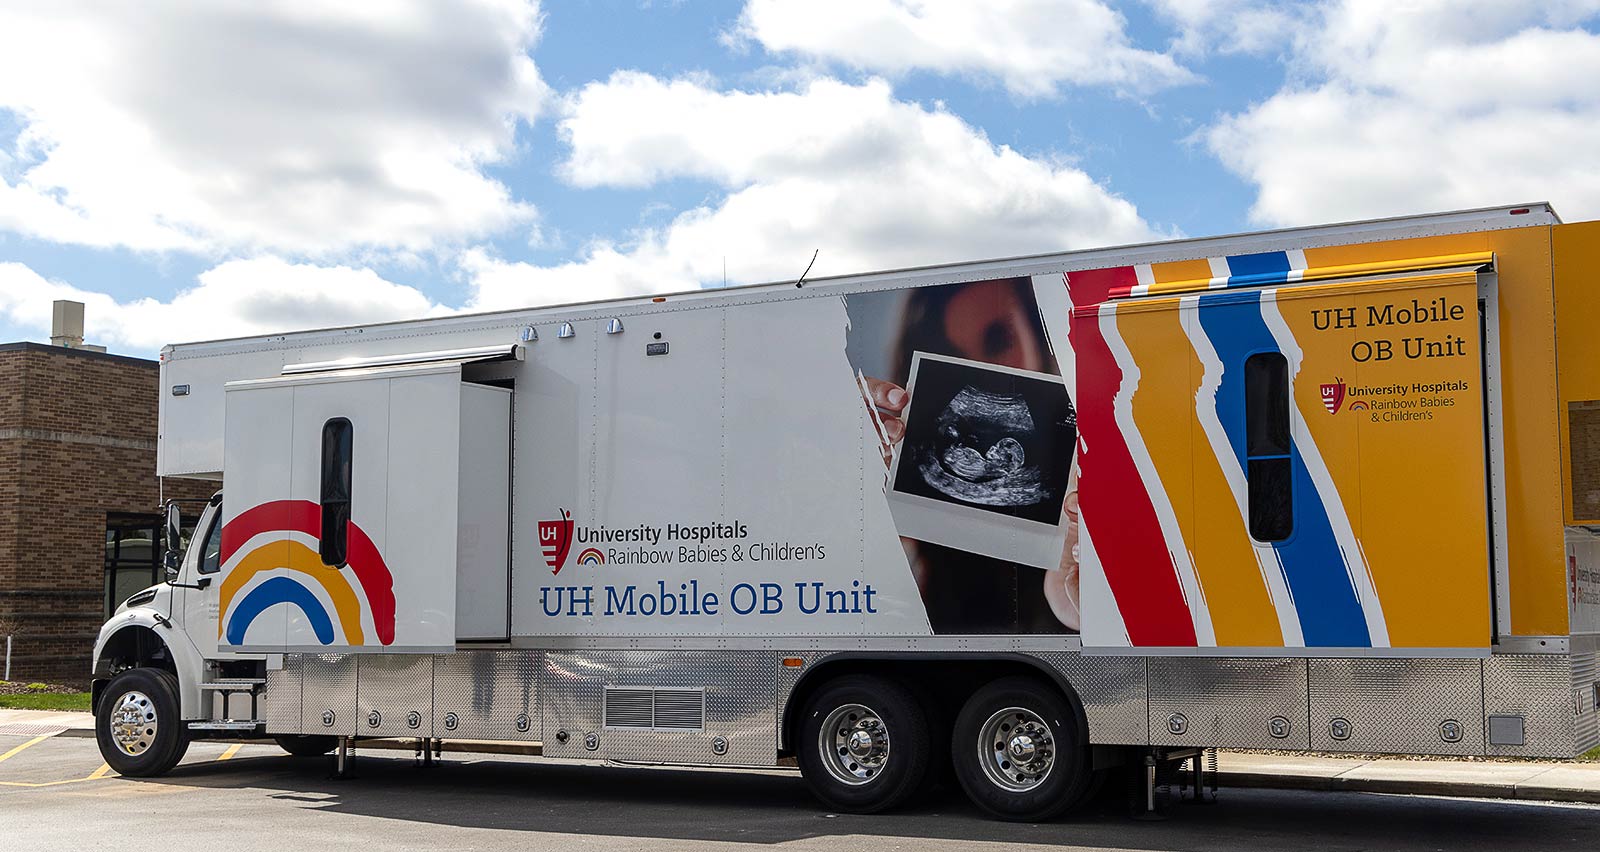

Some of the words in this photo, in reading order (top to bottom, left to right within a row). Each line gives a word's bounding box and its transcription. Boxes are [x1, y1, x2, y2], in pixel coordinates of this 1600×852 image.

[1310, 307, 1357, 331] UH
[1366, 297, 1464, 327] Mobile
[1351, 340, 1393, 363] OB
[1401, 334, 1466, 359] Unit
[1322, 387, 1334, 397] UH
[1348, 384, 1408, 397] University
[1412, 380, 1468, 396] Hospitals
[1370, 399, 1417, 410] Rainbow
[1420, 397, 1455, 408] Babies
[1371, 412, 1380, 422] &
[541, 526, 557, 541] UH
[577, 525, 662, 545] University
[667, 520, 748, 544] Hospitals
[608, 547, 674, 566] Rainbow
[678, 545, 727, 564] Babies
[731, 545, 744, 562] &
[748, 542, 826, 562] Children's
[540, 586, 594, 616] UH
[604, 579, 719, 616] Mobile
[730, 582, 784, 616] OB
[795, 580, 877, 615] Unit
